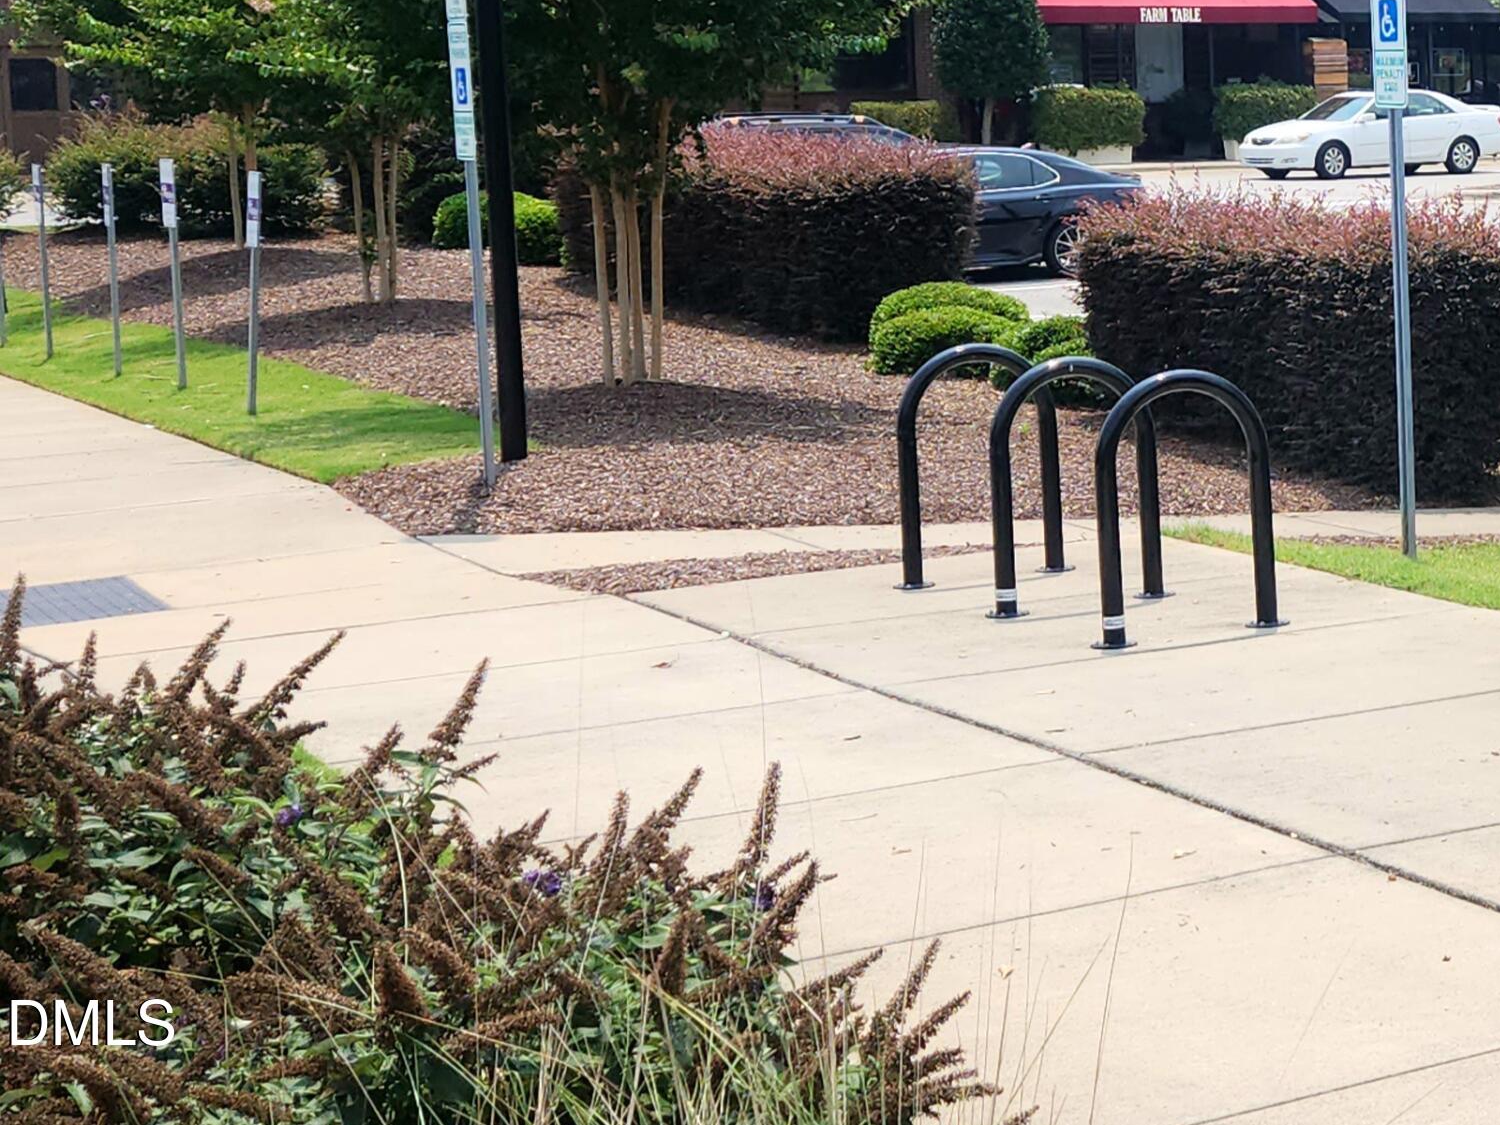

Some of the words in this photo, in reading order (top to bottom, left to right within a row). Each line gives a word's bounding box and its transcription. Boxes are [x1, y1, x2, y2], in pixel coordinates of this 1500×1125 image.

[1140, 7, 1168, 23] FARM
[1170, 7, 1202, 23] TABLE
[1376, 68, 1404, 79] PENALTY
